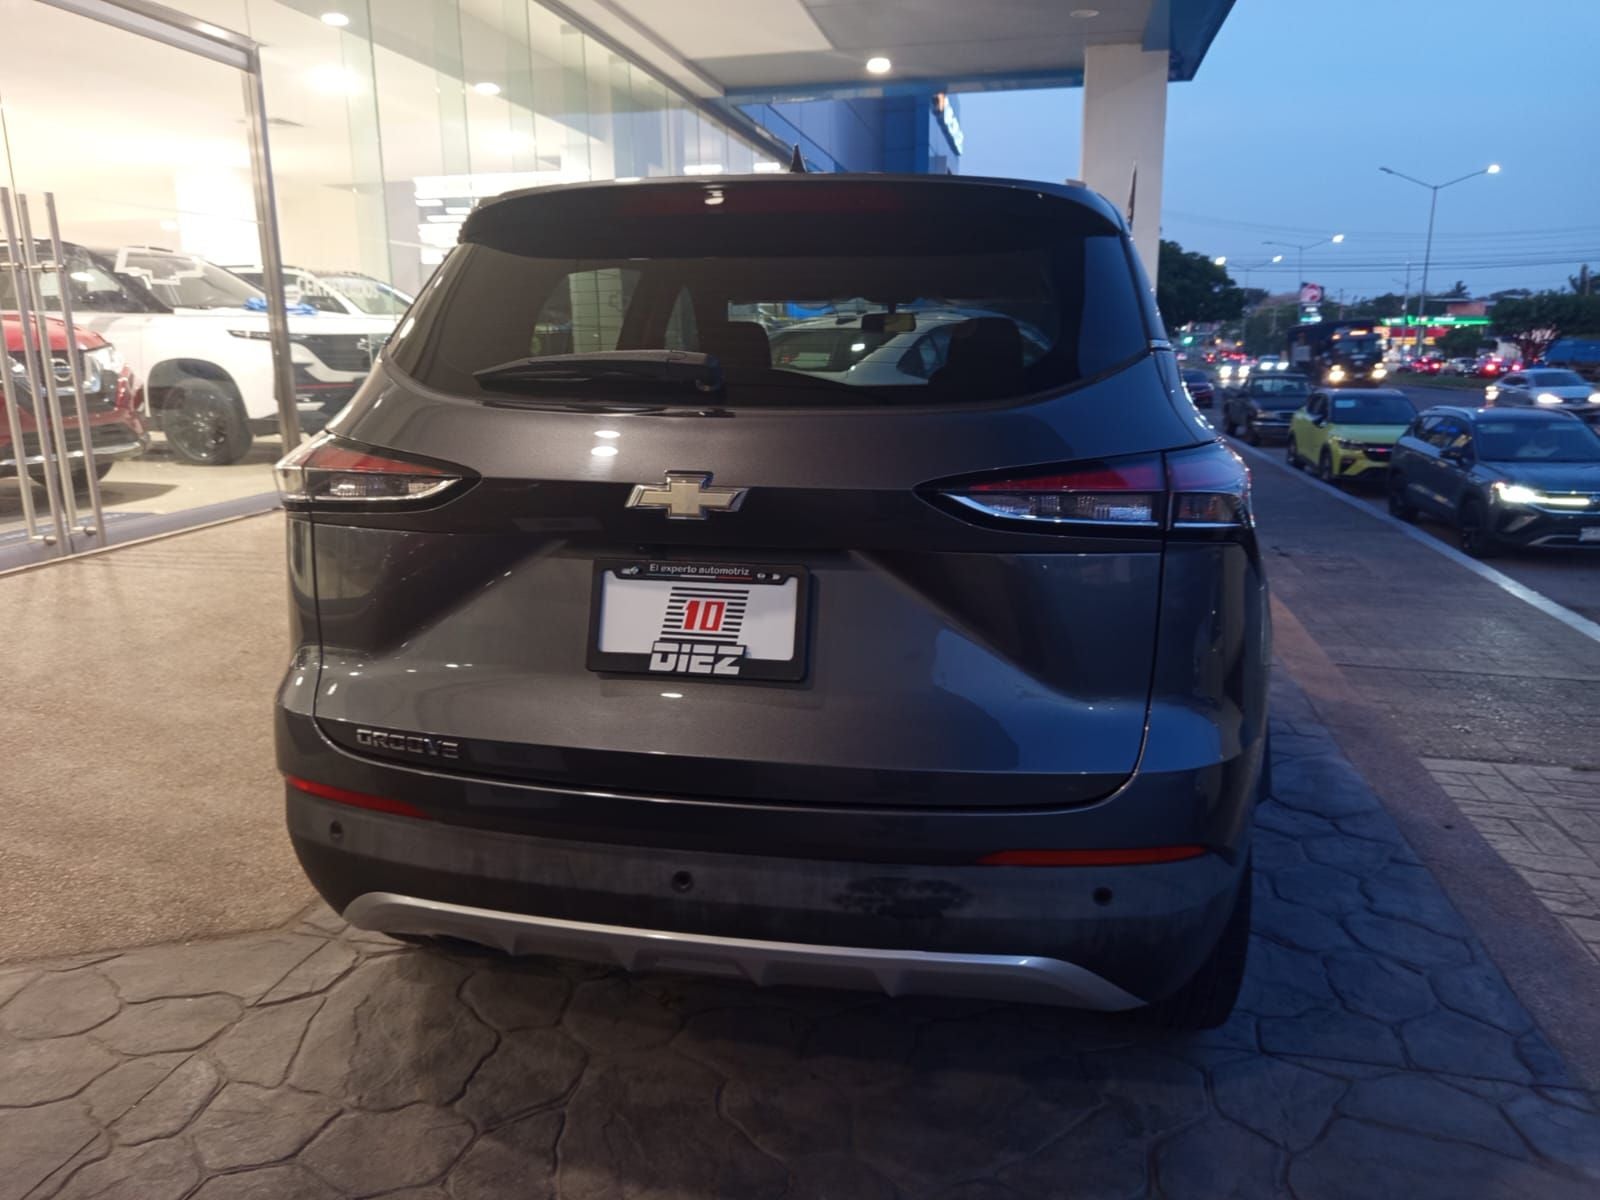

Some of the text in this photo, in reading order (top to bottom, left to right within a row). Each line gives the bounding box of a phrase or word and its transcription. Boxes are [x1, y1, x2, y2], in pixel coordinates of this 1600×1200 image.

[649, 563, 750, 576] El experto automotriz
[683, 600, 725, 632] 10
[649, 641, 746, 675] DIEZ
